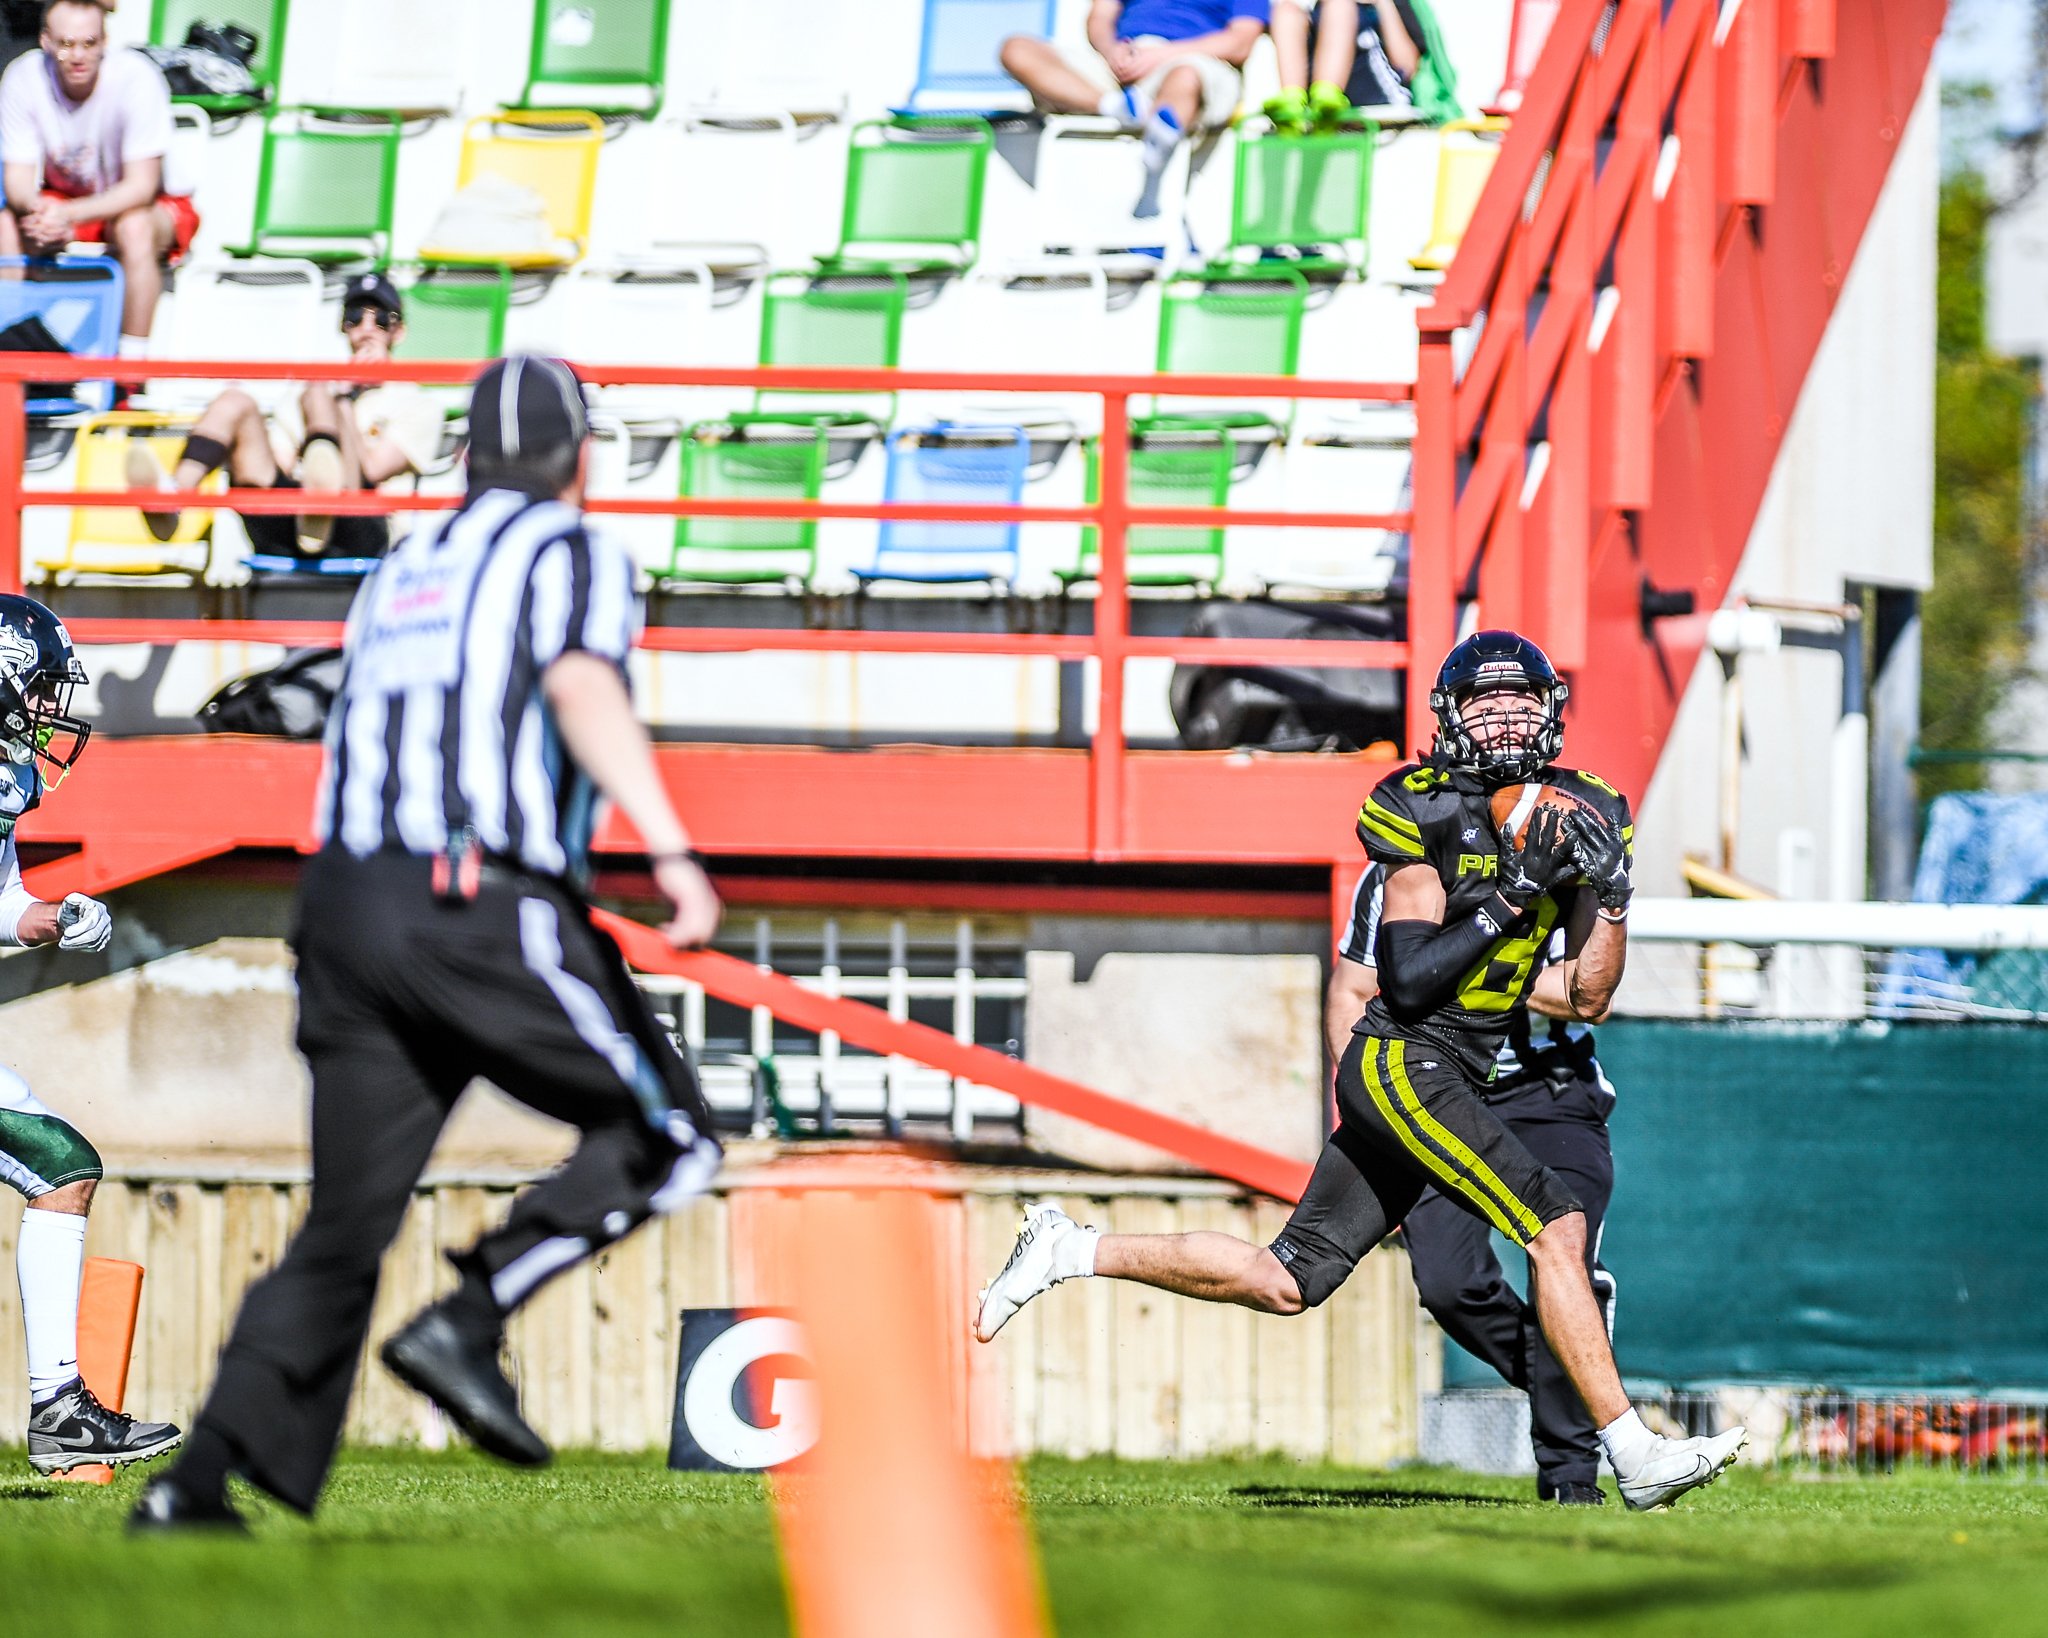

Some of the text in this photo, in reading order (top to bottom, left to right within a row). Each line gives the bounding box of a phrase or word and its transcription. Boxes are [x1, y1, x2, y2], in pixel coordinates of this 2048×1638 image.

[1457, 854, 1498, 877] PR
[1456, 893, 1558, 1010] 8
[684, 1317, 821, 1468] G
